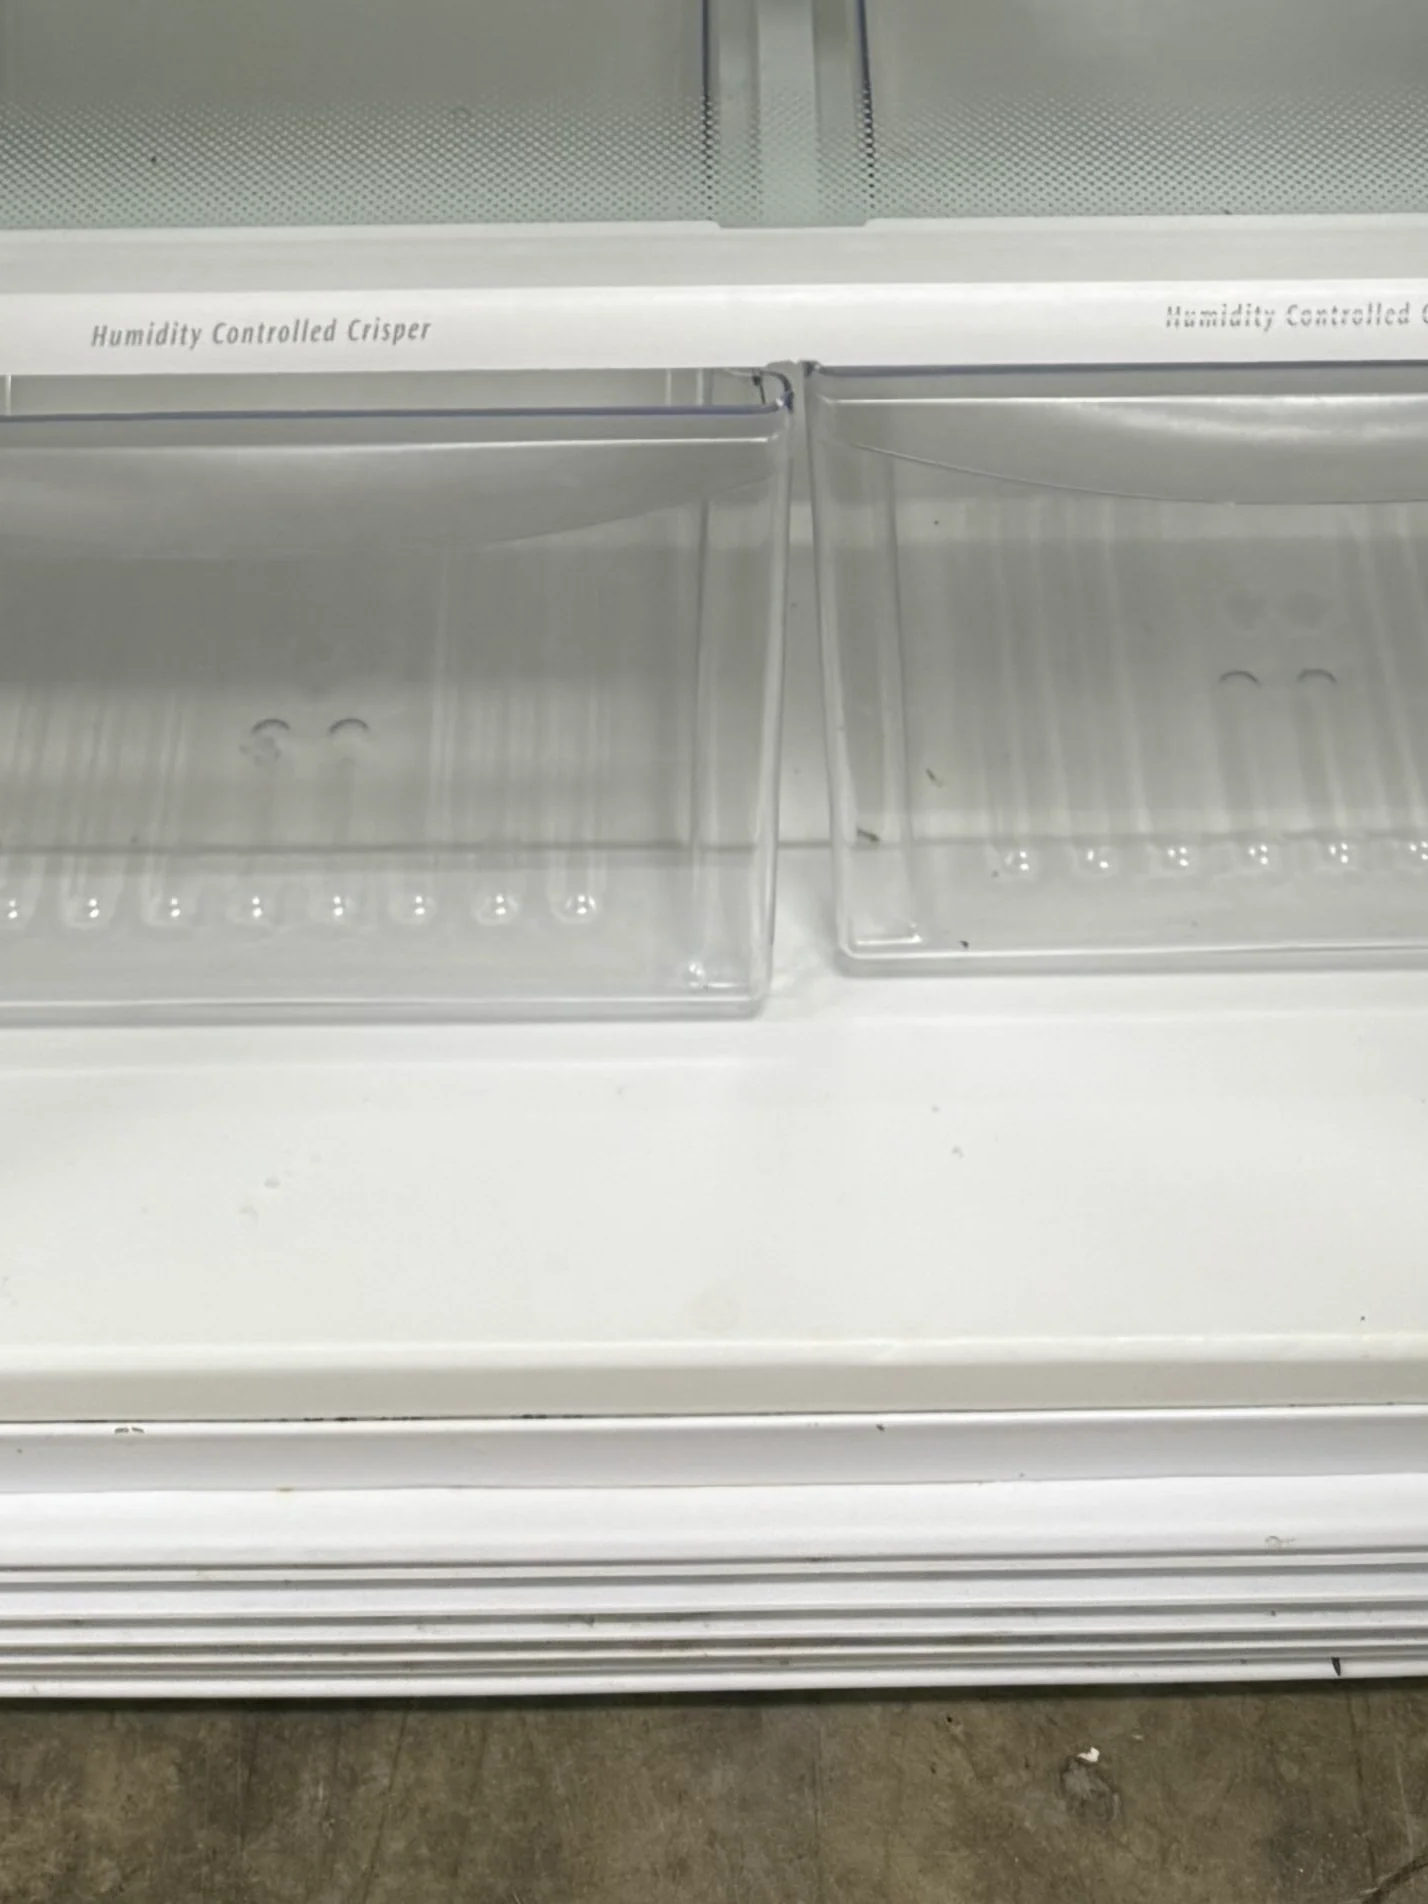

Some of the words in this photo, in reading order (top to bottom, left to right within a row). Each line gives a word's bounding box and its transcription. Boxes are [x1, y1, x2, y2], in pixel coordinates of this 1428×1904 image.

[1165, 303, 1276, 332] Humidity
[1286, 302, 1411, 327] Controlled
[90, 321, 202, 351] Humidity
[212, 319, 338, 344] Controlled
[347, 317, 432, 346] Crisper
